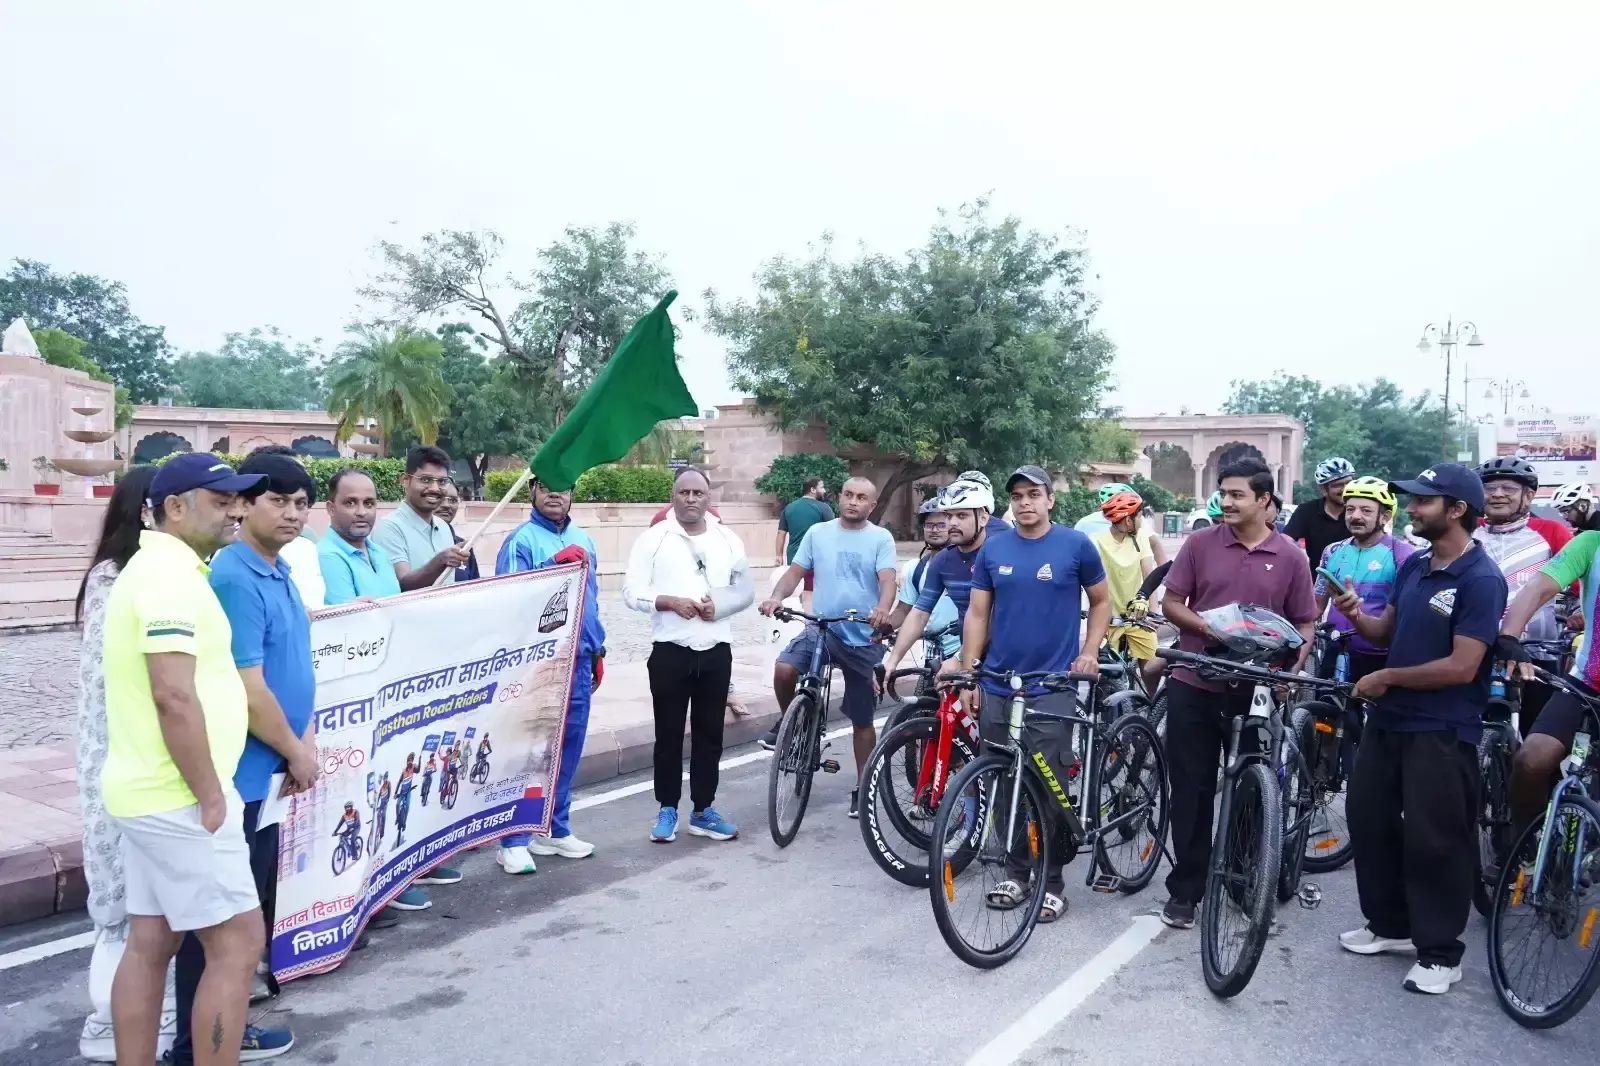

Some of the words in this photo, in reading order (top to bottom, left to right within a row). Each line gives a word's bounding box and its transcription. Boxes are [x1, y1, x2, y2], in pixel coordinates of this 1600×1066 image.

[314, 697, 375, 734] दाता
[459, 648, 525, 683] साइकिल
[526, 639, 558, 663] राइड
[376, 711, 421, 744] jasthan
[422, 700, 453, 720] Road
[454, 689, 489, 706] Riders
[867, 754, 905, 870] BONTRAGER
[1032, 752, 1070, 808] GIANT
[292, 930, 339, 956] जिला
[393, 853, 419, 877] जयपुर
[426, 824, 468, 854] राजस्थान
[467, 818, 482, 834] रोड
[483, 805, 517, 829] राइडर्स
[312, 895, 355, 919] दिनांक
